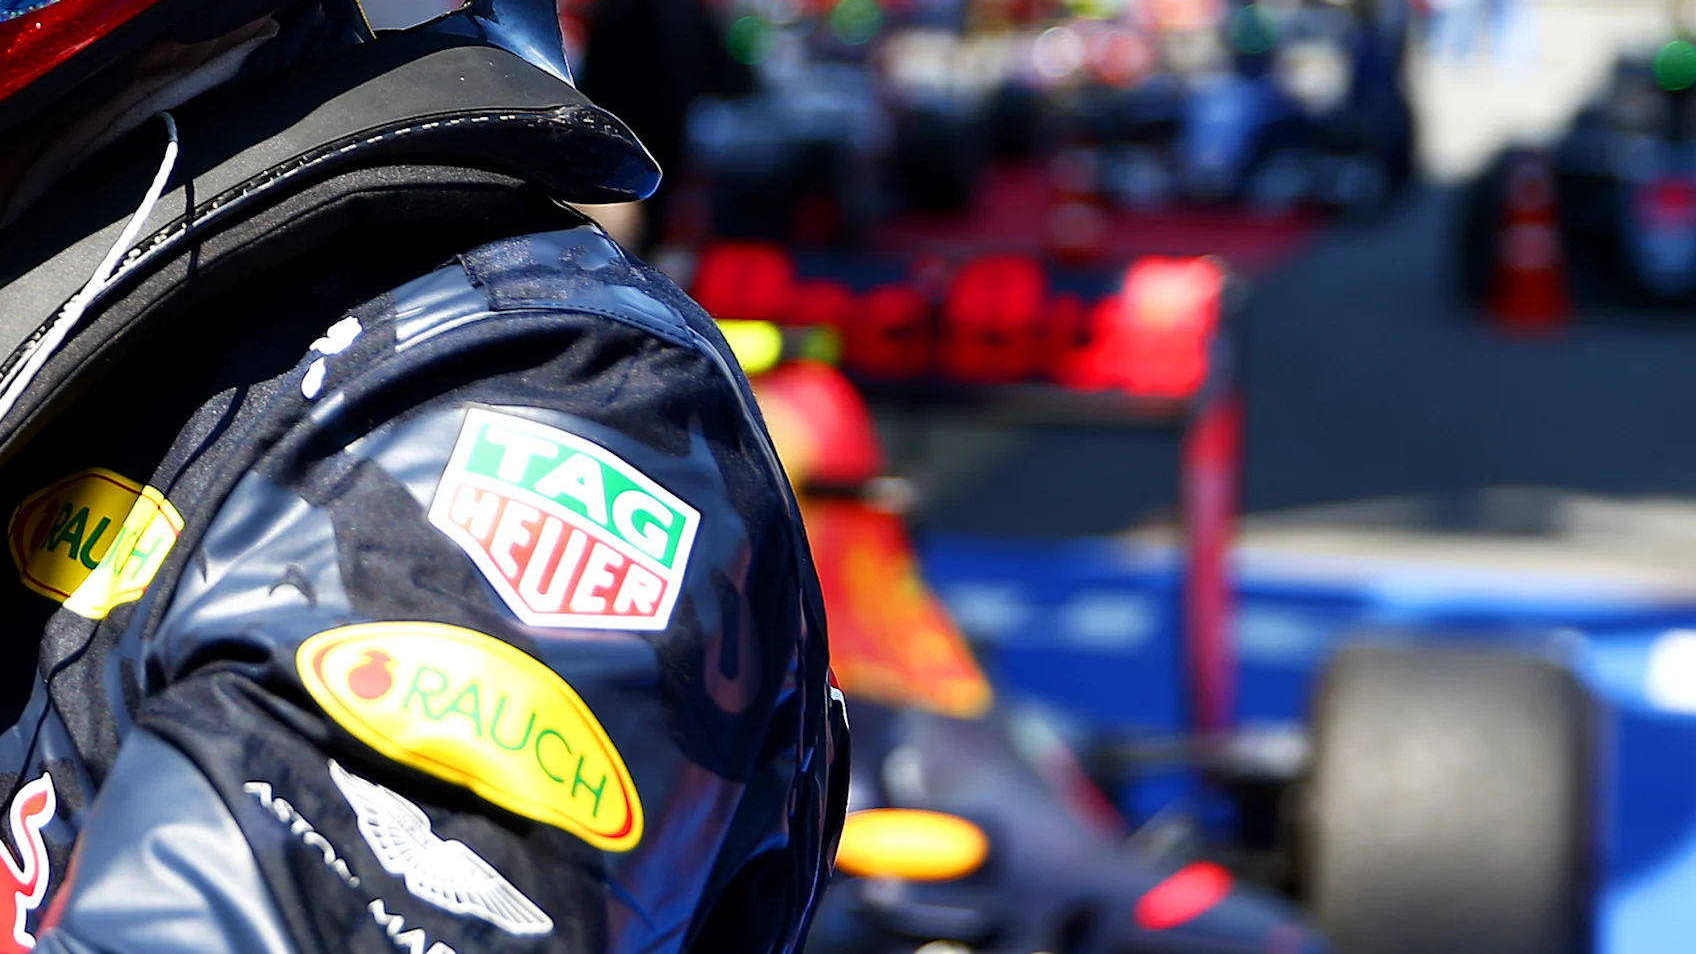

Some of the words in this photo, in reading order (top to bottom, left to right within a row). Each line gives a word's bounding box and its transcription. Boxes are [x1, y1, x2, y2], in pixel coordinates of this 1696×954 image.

[41, 502, 164, 580] RAUCH
[449, 484, 663, 614] HEUER
[485, 427, 674, 560] TAG
[404, 666, 607, 817] RAUCH
